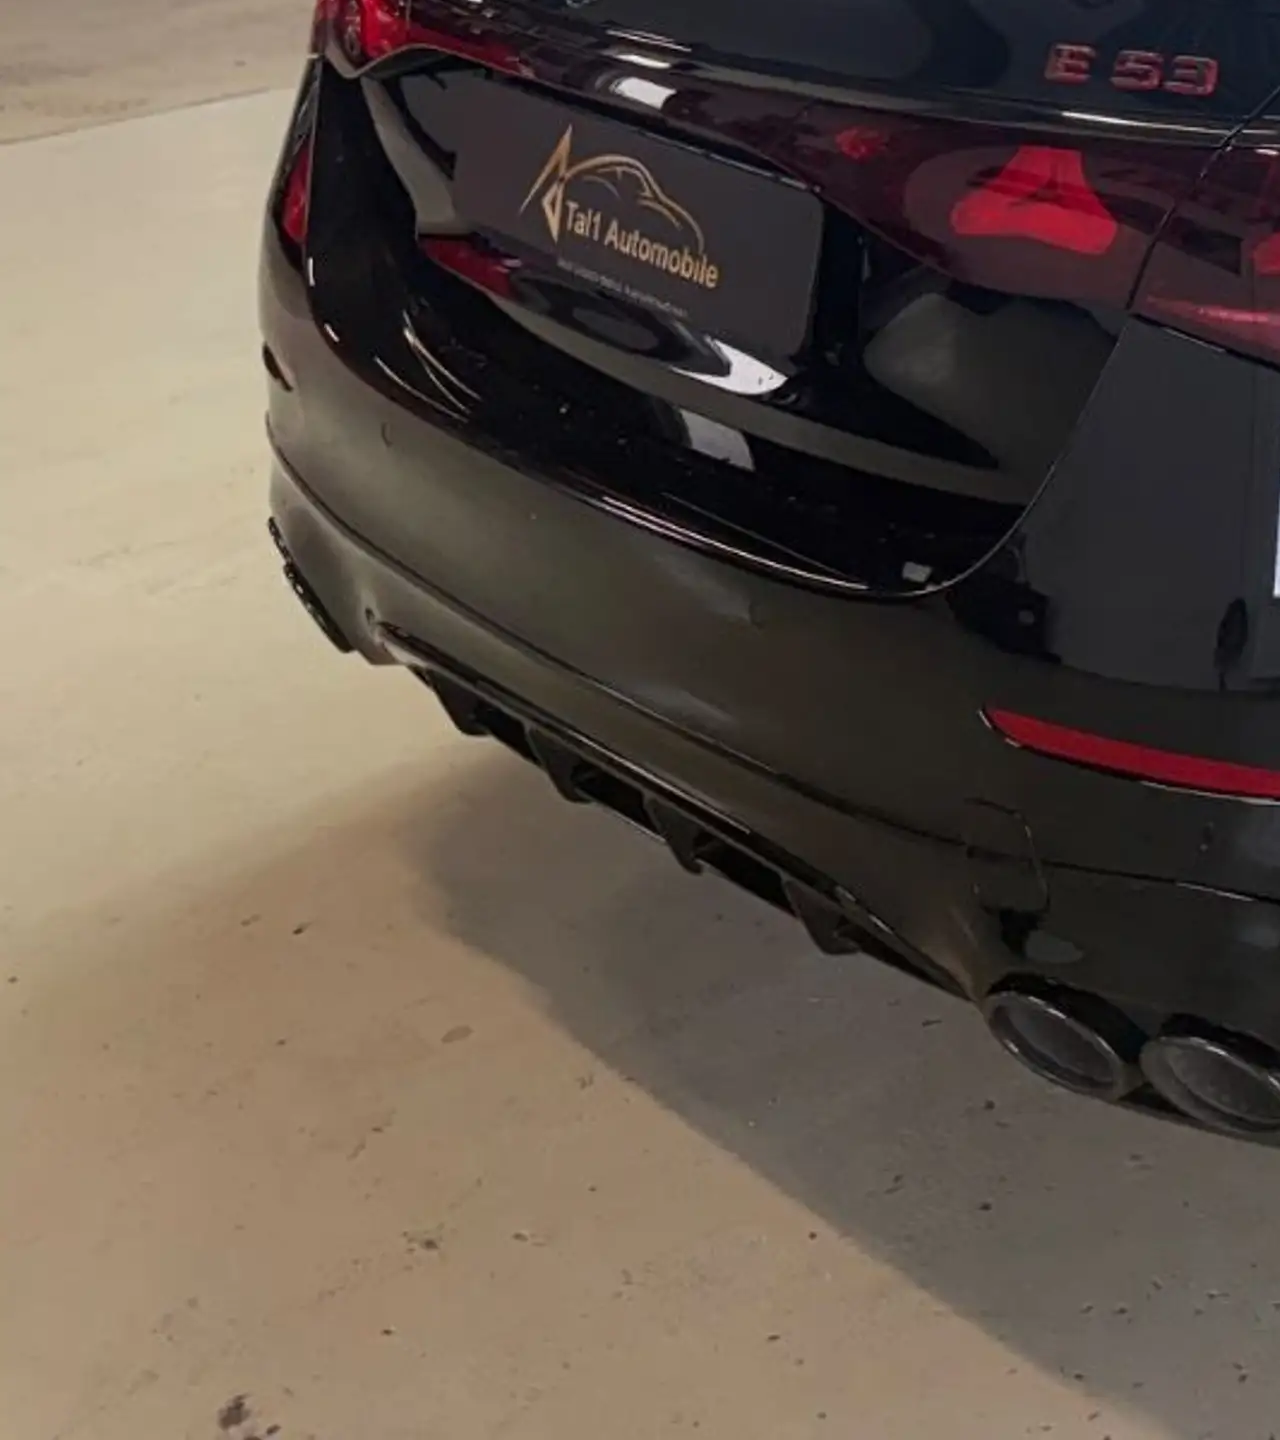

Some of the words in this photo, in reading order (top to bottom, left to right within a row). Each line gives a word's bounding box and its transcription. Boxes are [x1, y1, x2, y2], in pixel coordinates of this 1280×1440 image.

[1044, 43, 1096, 85] E
[1109, 48, 1220, 97] 53
[604, 220, 720, 289] Automobile
